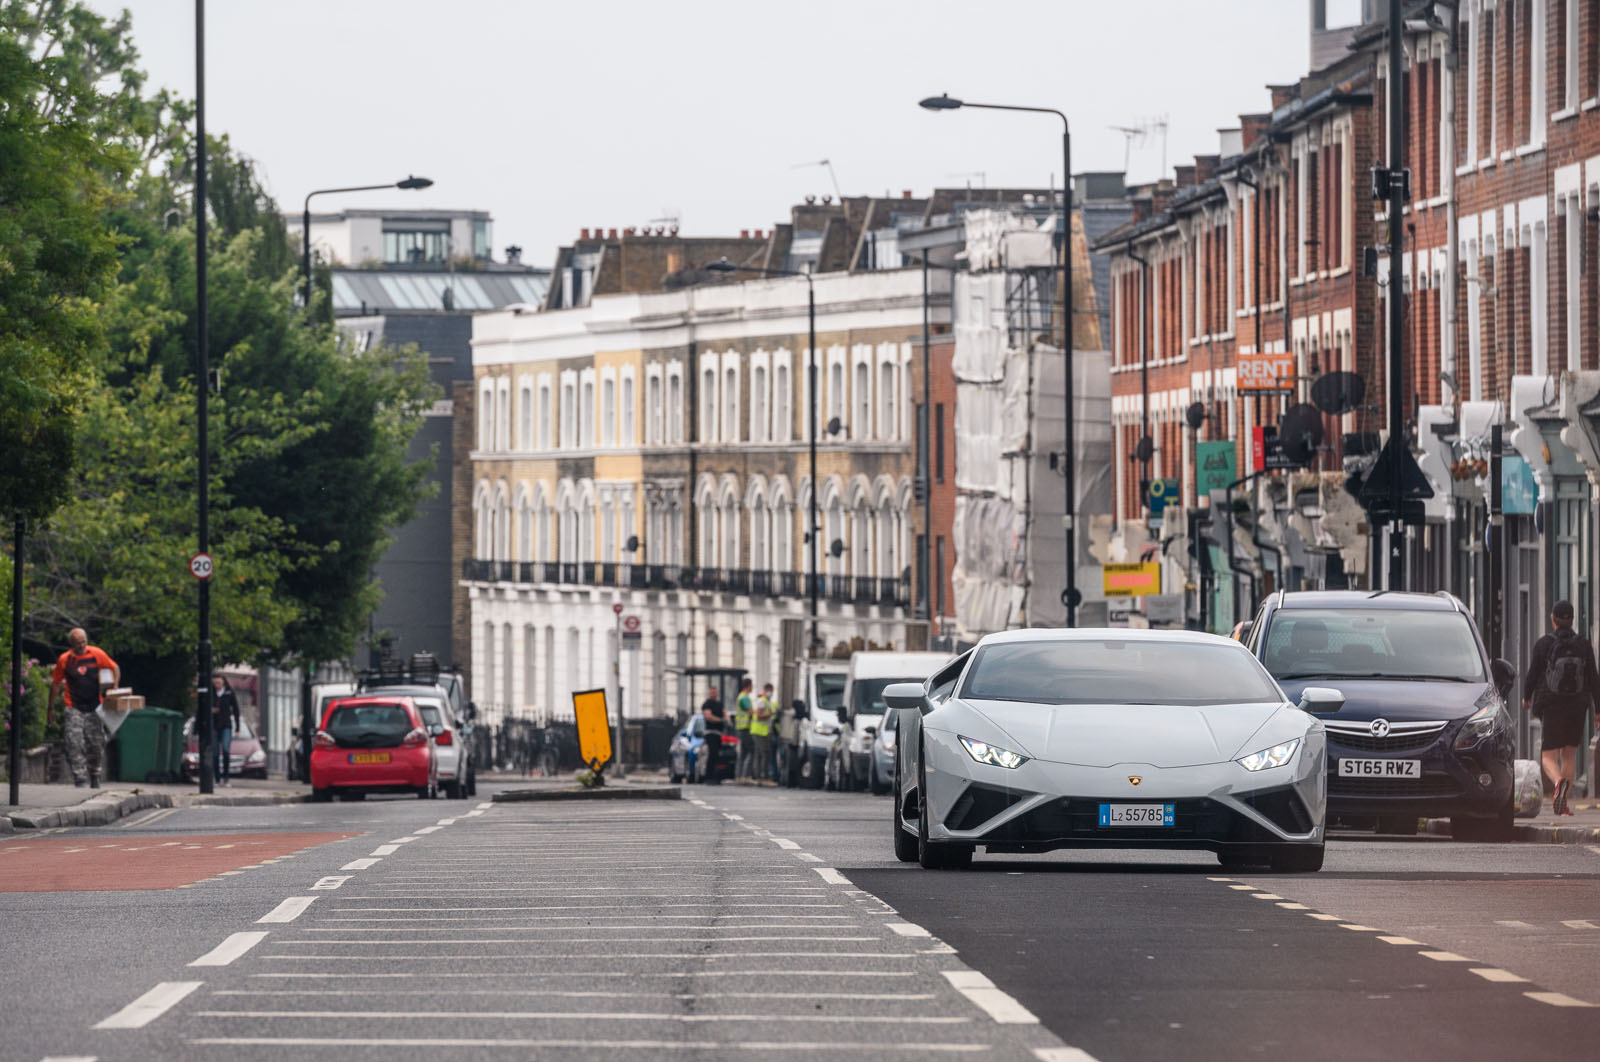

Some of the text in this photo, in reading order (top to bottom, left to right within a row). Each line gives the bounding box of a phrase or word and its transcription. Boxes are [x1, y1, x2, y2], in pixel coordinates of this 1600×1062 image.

[1238, 360, 1292, 378] RENT
[194, 560, 211, 572] 20
[1344, 760, 1414, 776] ST65 RWZ
[1125, 808, 1163, 822] 55785
